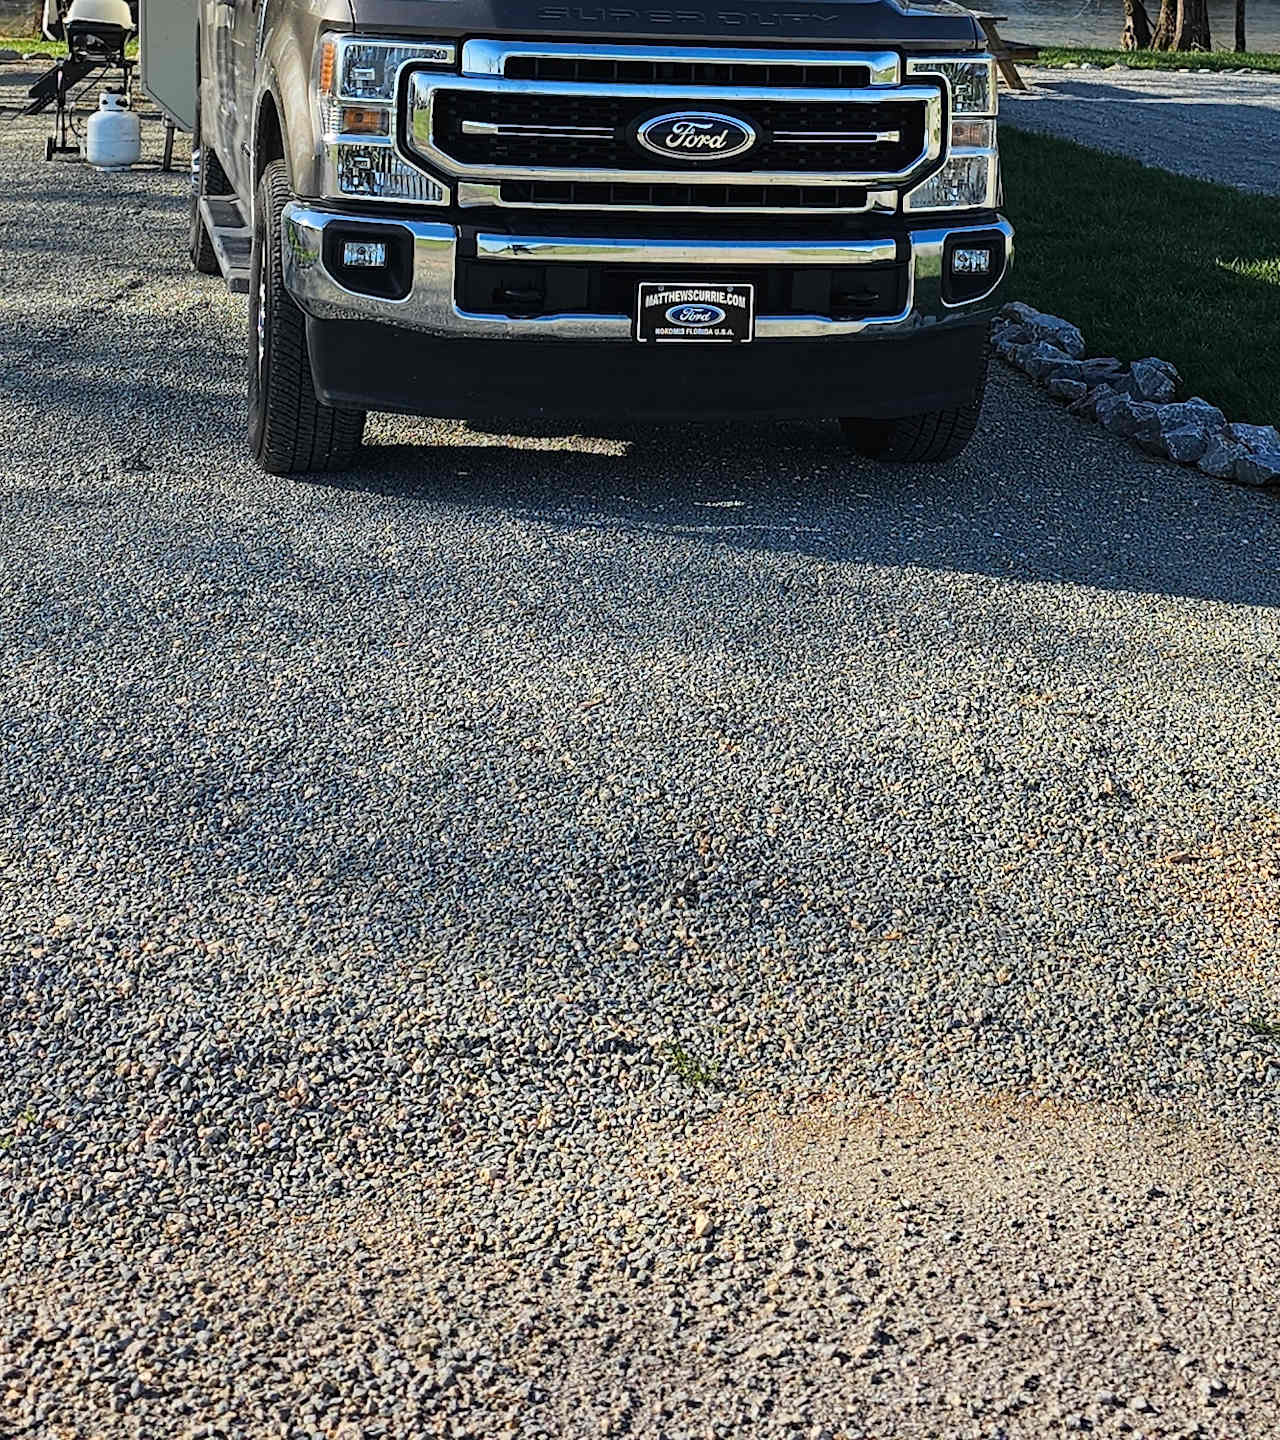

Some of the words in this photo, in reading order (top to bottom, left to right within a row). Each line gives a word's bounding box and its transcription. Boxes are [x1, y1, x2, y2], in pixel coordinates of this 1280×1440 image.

[536, 6, 705, 24] SUPER
[717, 10, 840, 26] DUTY
[665, 121, 728, 148] Ford
[645, 289, 746, 309] MATTHEWSCURRIE.COM
[679, 307, 712, 322] Ford
[685, 327, 713, 336] FLORIDA
